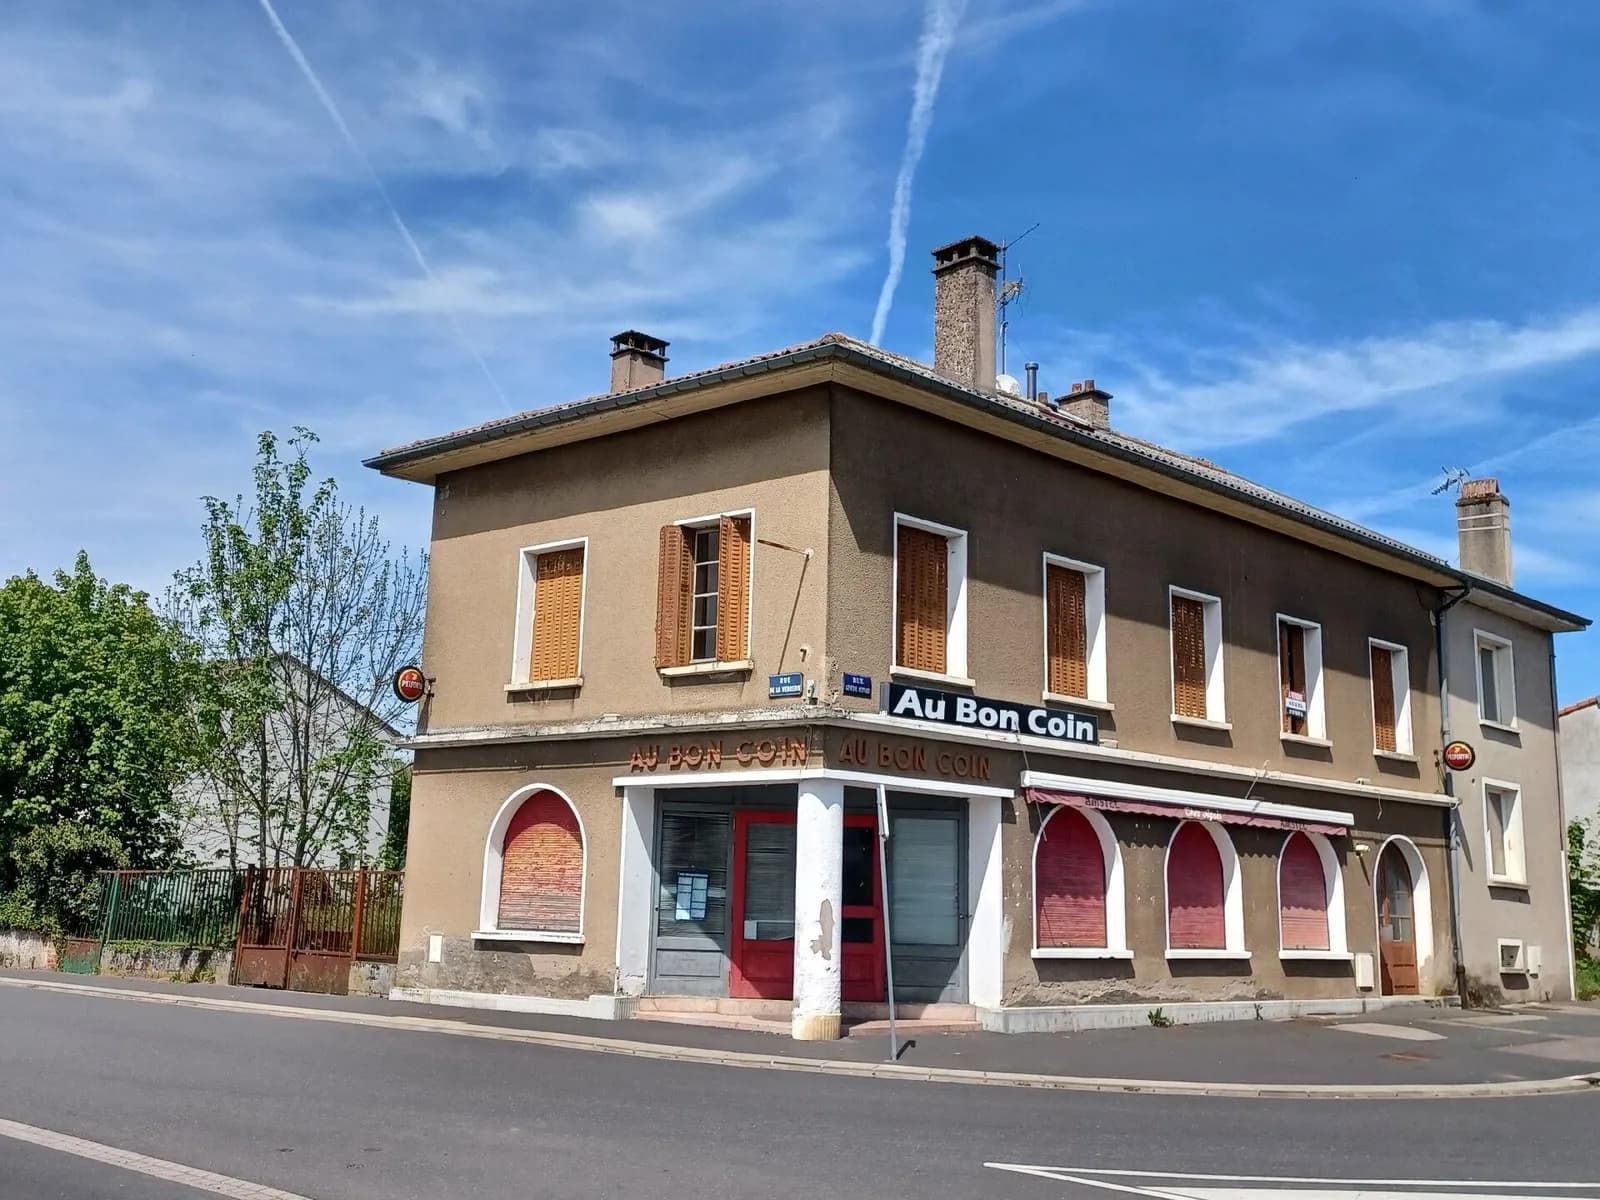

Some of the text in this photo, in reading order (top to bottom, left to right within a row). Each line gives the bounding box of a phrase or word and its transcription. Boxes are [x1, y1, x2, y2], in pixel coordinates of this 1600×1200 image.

[893, 689, 1095, 742] Au Bon Coin
[630, 736, 808, 772] AU BON COIN
[839, 736, 992, 780] AU BON COIN
